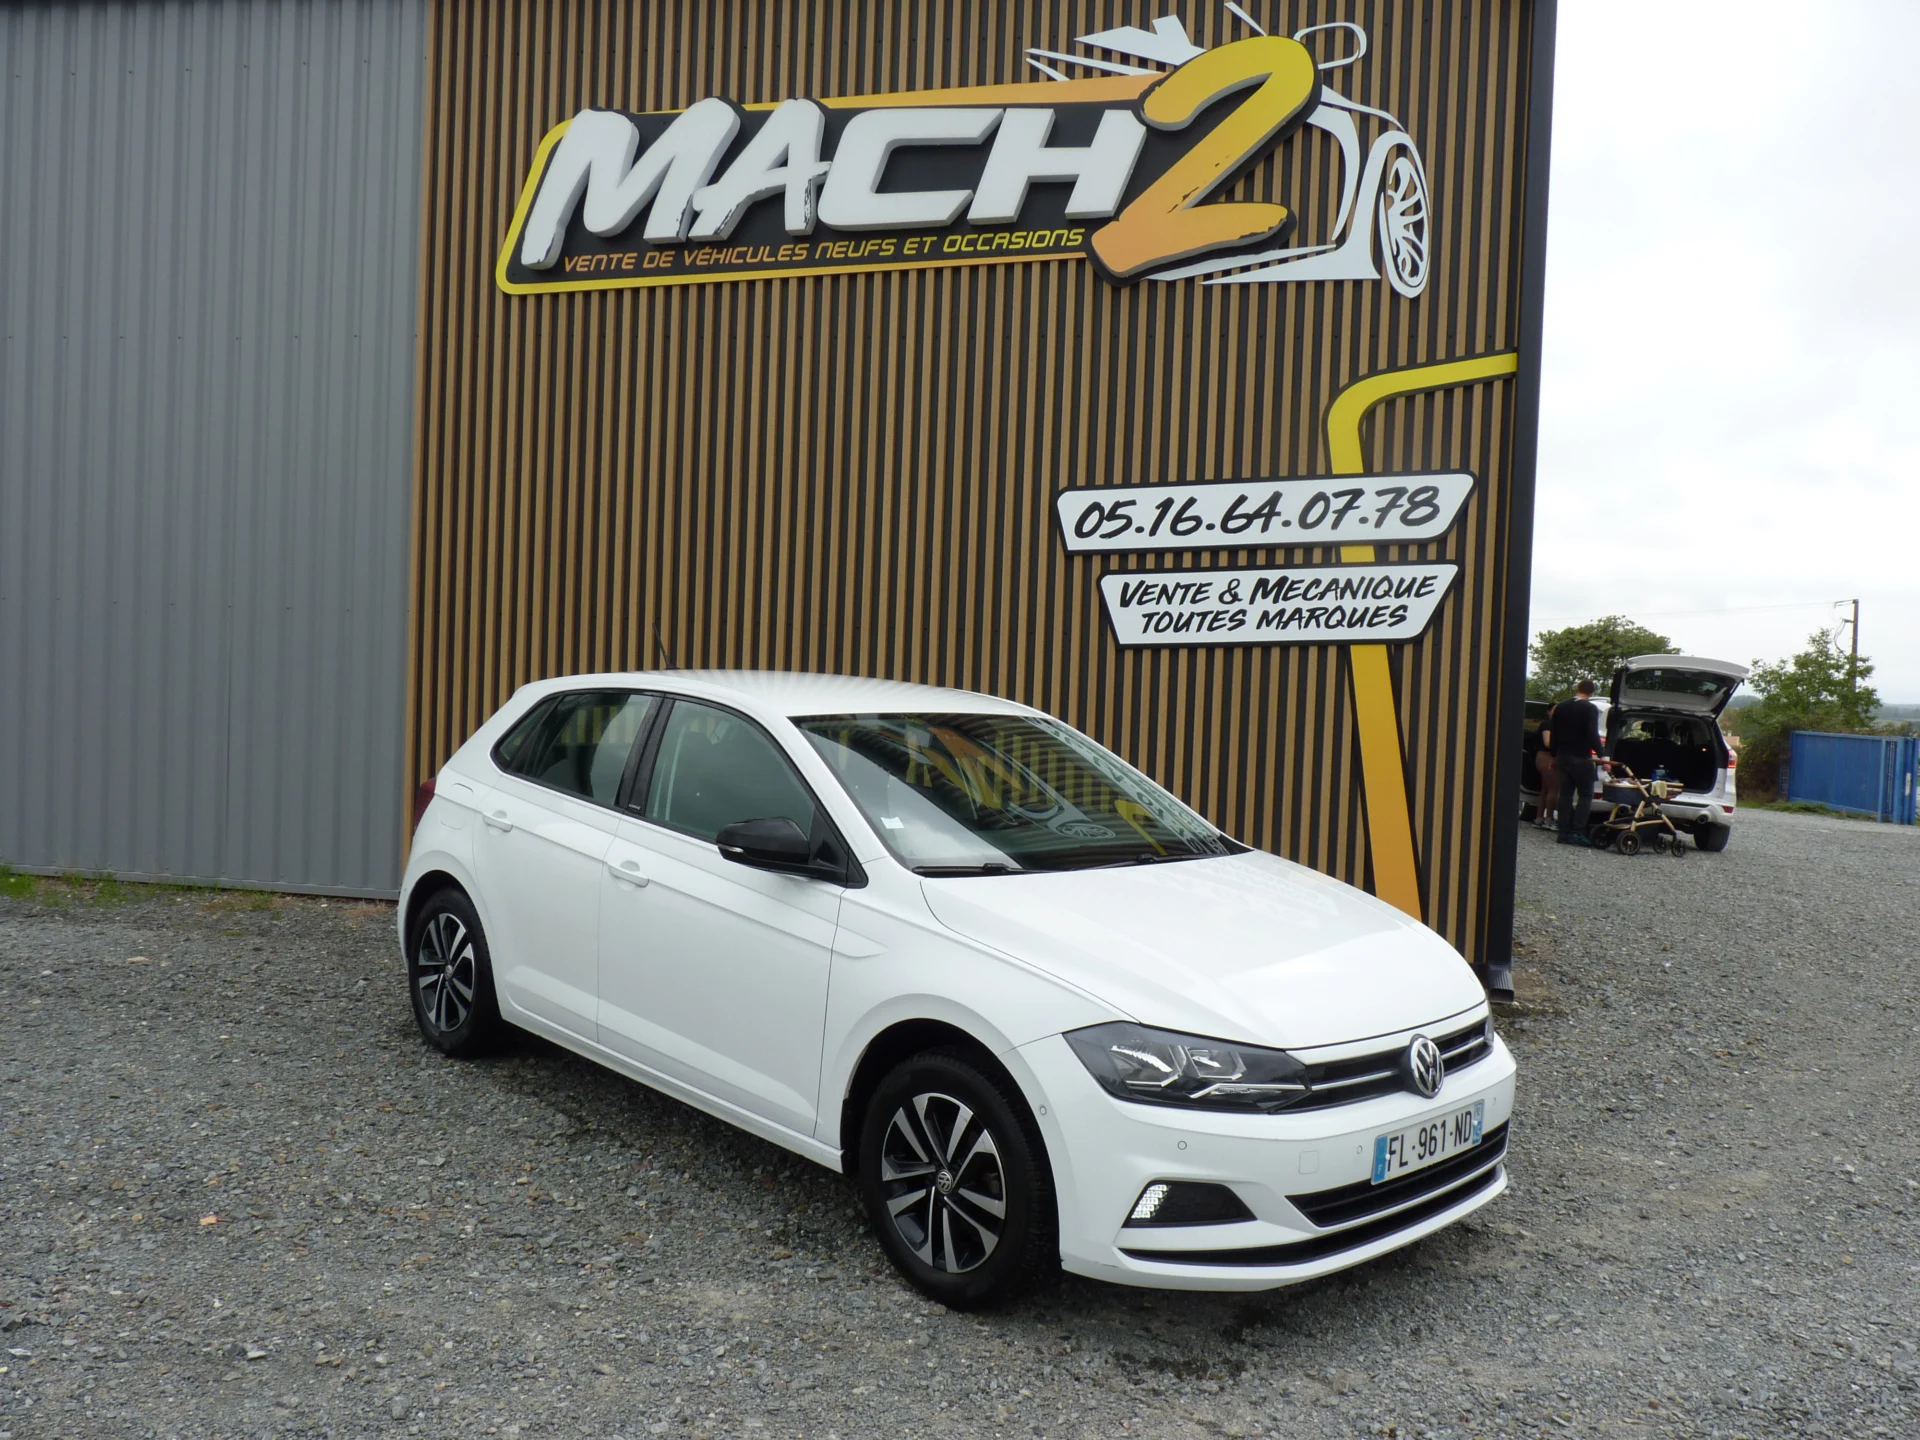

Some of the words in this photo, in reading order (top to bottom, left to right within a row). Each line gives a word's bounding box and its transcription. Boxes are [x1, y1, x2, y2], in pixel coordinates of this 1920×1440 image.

[521, 98, 1146, 270] MACH
[1092, 35, 1315, 278] 2
[564, 252, 638, 272] VENTE
[642, 250, 675, 268] DE
[683, 243, 810, 266] VÉHICULES
[814, 238, 897, 260] NEUFS
[903, 235, 937, 254] ET
[942, 228, 1085, 252] OCCASIONS
[1073, 485, 1441, 539] 05.16.64.07.78
[1119, 580, 1214, 608] VENTE
[1218, 578, 1242, 604] &
[1249, 573, 1440, 605] MECANIQUE
[1141, 608, 1247, 634] TOUTES
[1256, 604, 1409, 630] MARQUES
[1387, 1110, 1472, 1172] FL-961-ND
